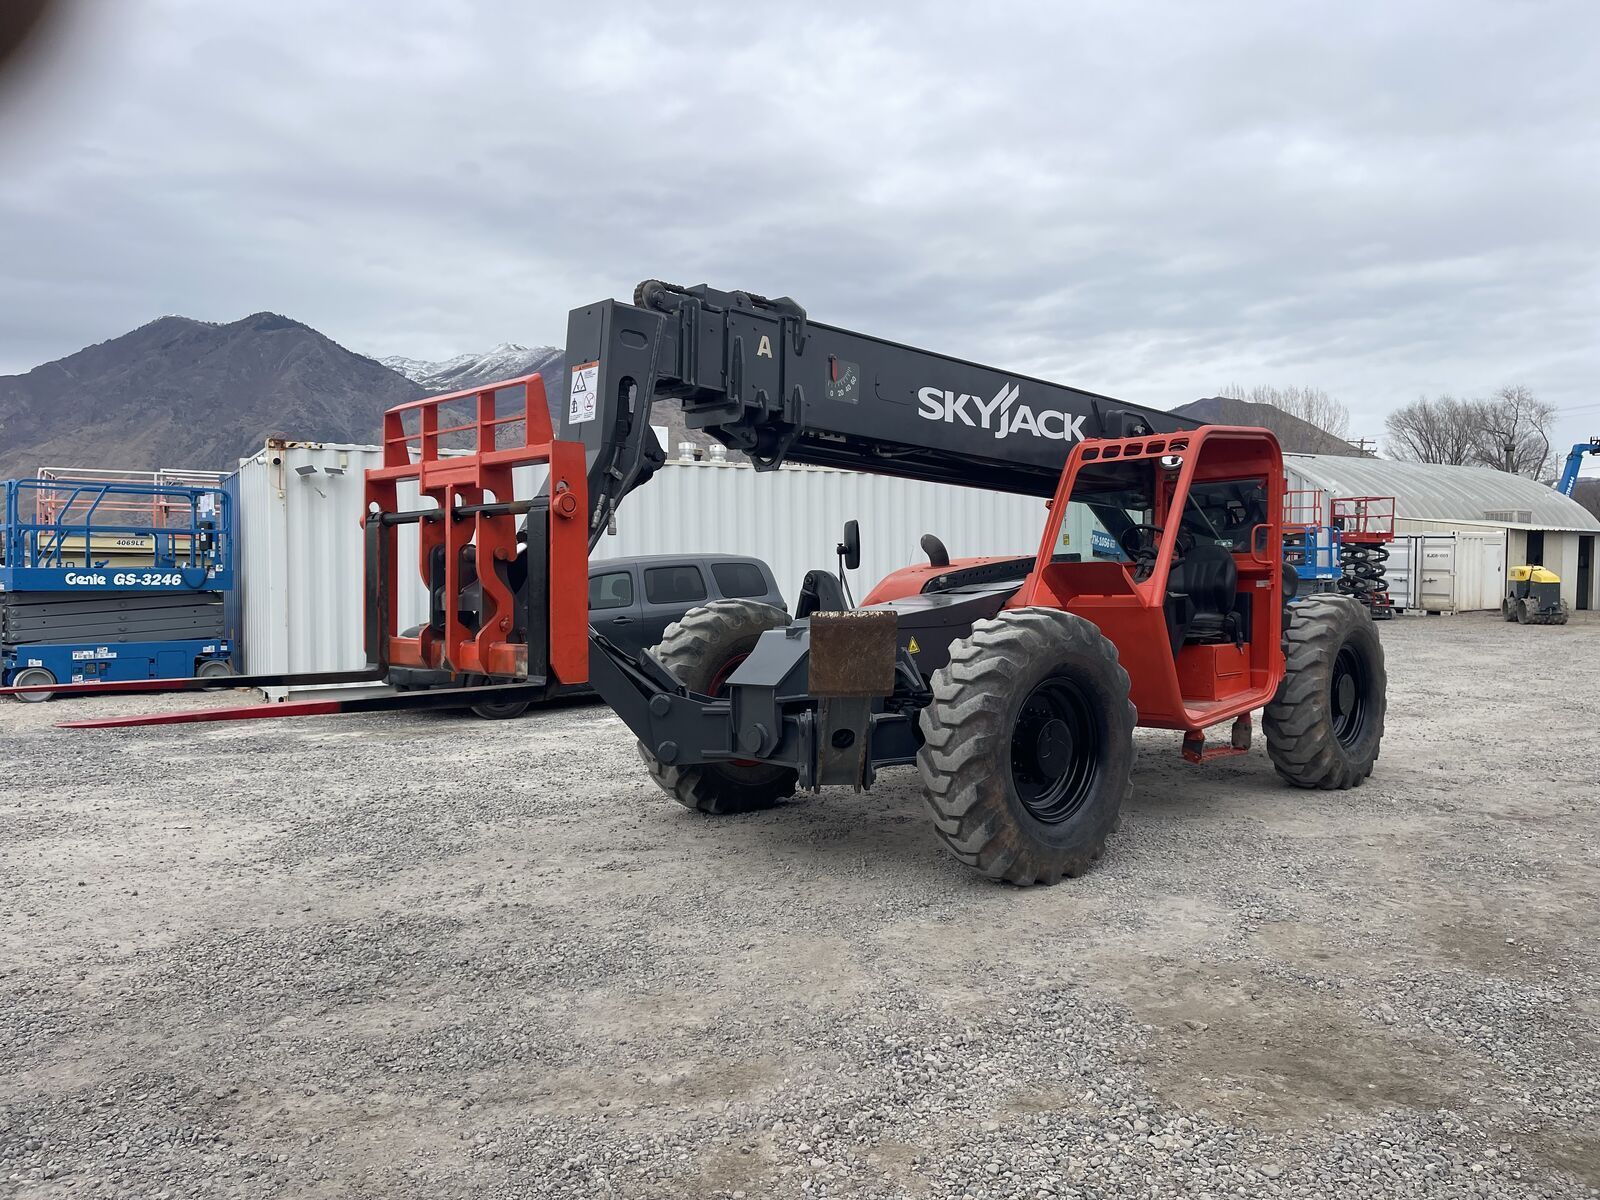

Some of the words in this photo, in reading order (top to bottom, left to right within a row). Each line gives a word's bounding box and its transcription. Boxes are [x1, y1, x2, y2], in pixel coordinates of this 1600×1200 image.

[757, 335, 773, 358] A
[918, 381, 1087, 442] SKYJACK
[65, 572, 107, 585] Genie
[113, 573, 182, 586] GS-3246
